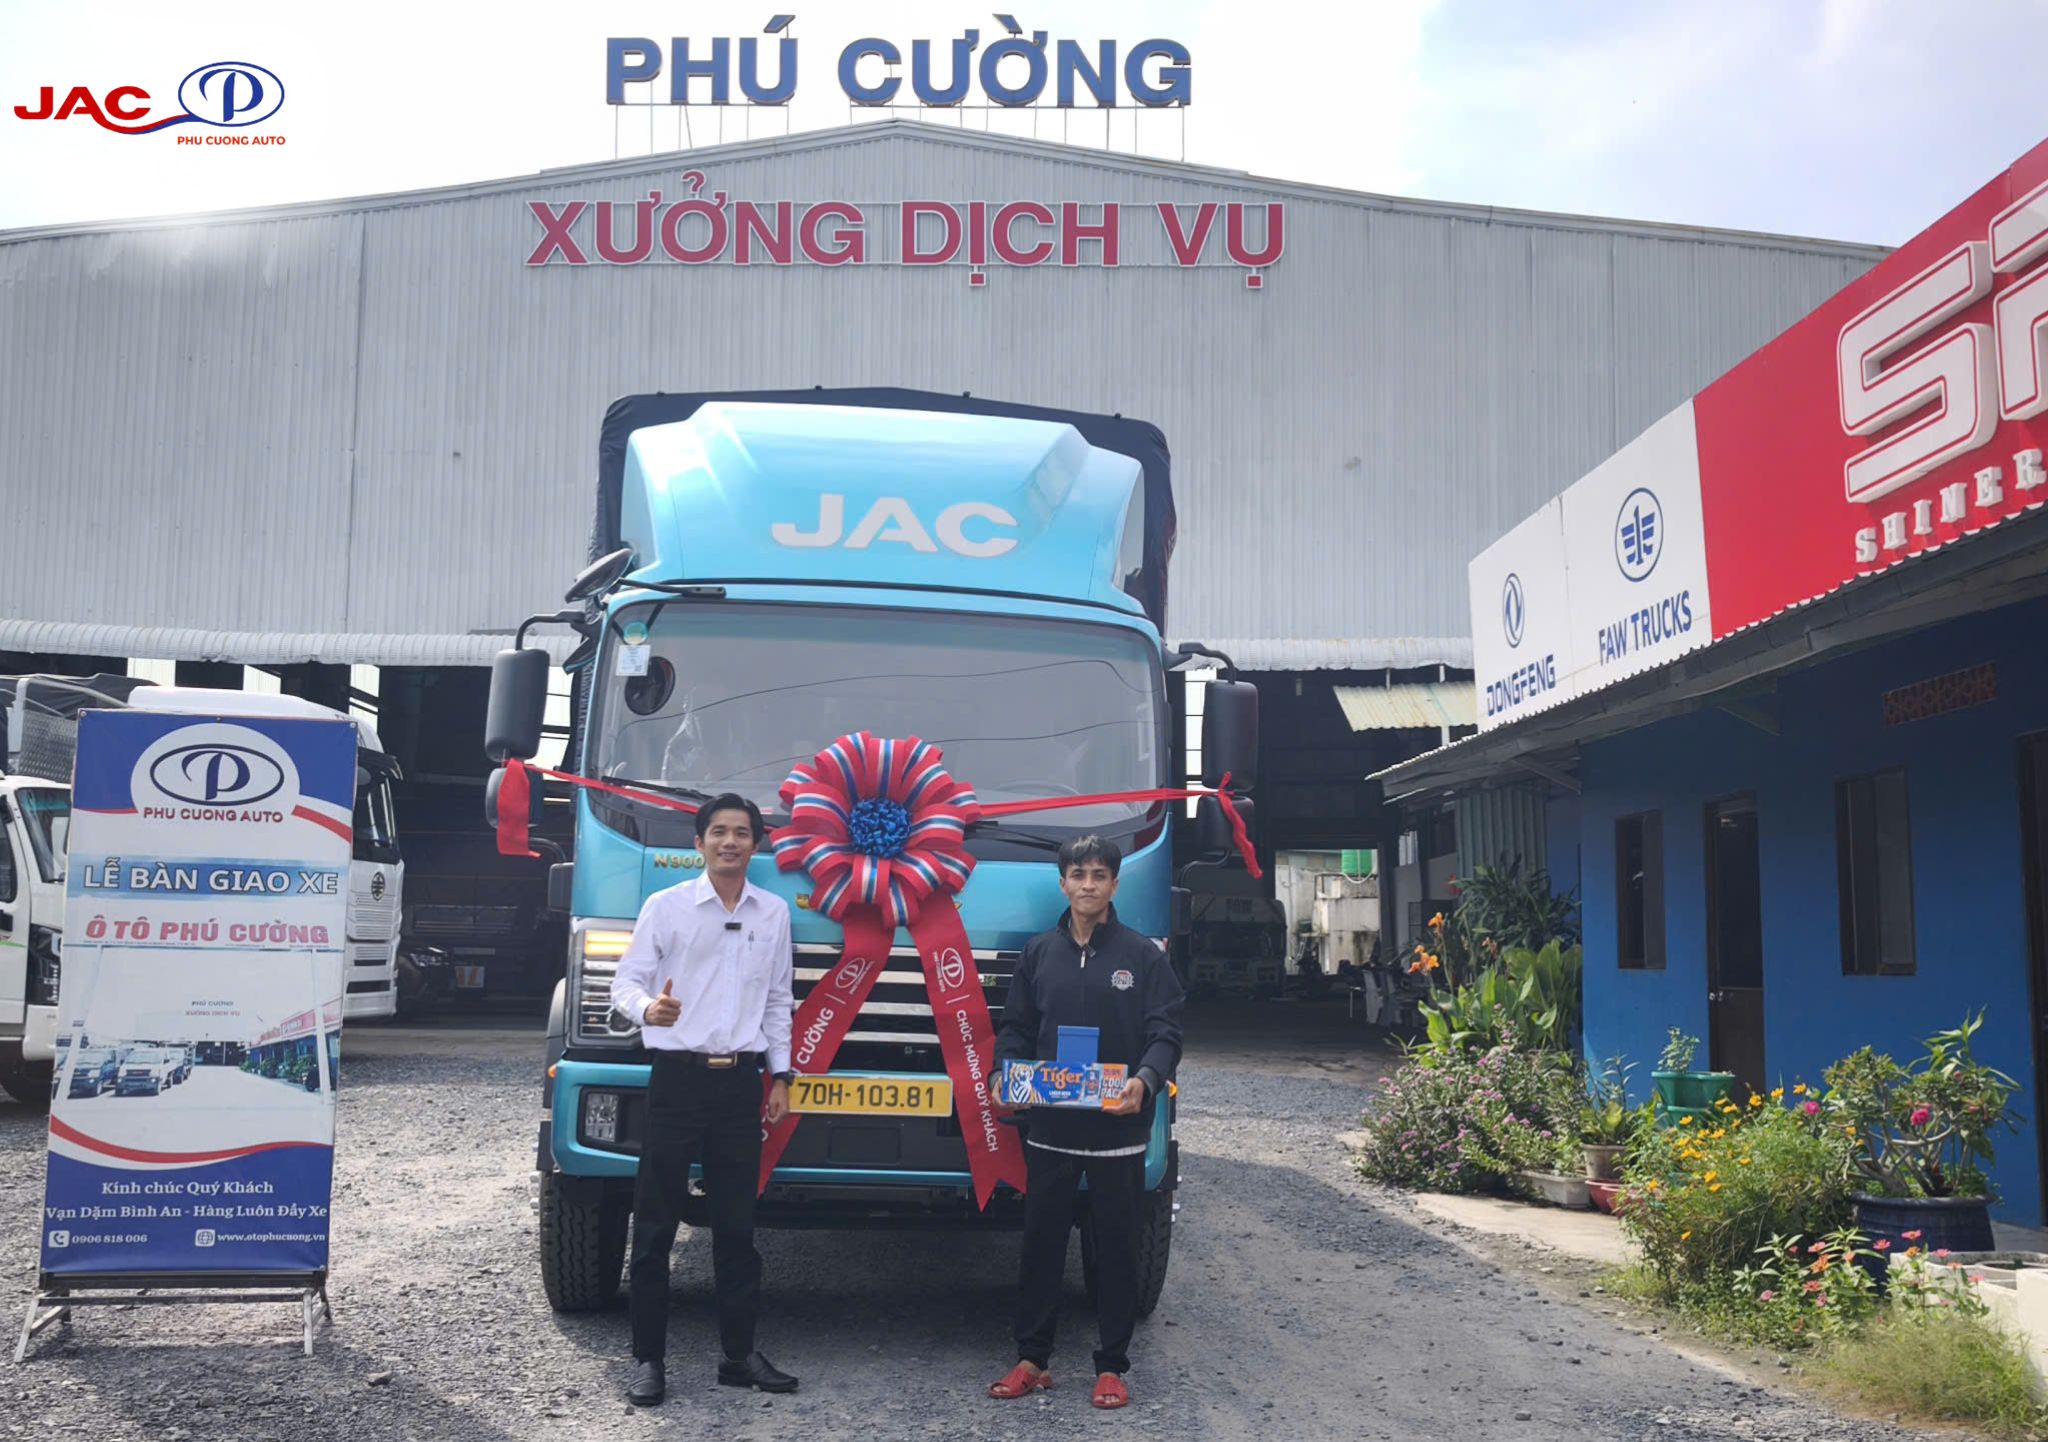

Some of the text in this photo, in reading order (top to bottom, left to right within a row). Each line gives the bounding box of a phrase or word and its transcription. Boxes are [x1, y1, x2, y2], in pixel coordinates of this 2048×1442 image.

[606, 13, 1192, 108] PHÚ CƯỜNG
[525, 170, 1286, 289] XƯỞNG DỊCH VỤ
[1855, 448, 2048, 563] SHINER
[771, 492, 1019, 558] JAC
[1598, 590, 1693, 667] FAW TRUCKS
[1486, 653, 1556, 717] DONGFENG
[143, 806, 283, 823] PHU CUONG AUTO
[84, 857, 339, 894] LỄ BÀN GIAO XE
[86, 914, 330, 944] Ô TÔ PHÚ CƯỜNG
[796, 1007, 834, 1065] CƯỜNG
[798, 1082, 935, 1109] 70H-103.81
[956, 1009, 999, 1153] CHÚC MỪNG QUÝ KHÁCH
[1040, 1066, 1084, 1090] Tiger
[1100, 1088, 1121, 1099] PAC
[101, 1181, 274, 1196] Kính chúc Quý Khách
[46, 1207, 77, 1221] Vạn
[80, 1206, 117, 1220] Dặm
[120, 1205, 157, 1218] Bình
[160, 1206, 182, 1217] An
[193, 1204, 234, 1219] Hàng
[236, 1204, 274, 1217] Luôn
[308, 1206, 328, 1217] Xe
[217, 1232, 326, 1243] www.otophucuong.vn
